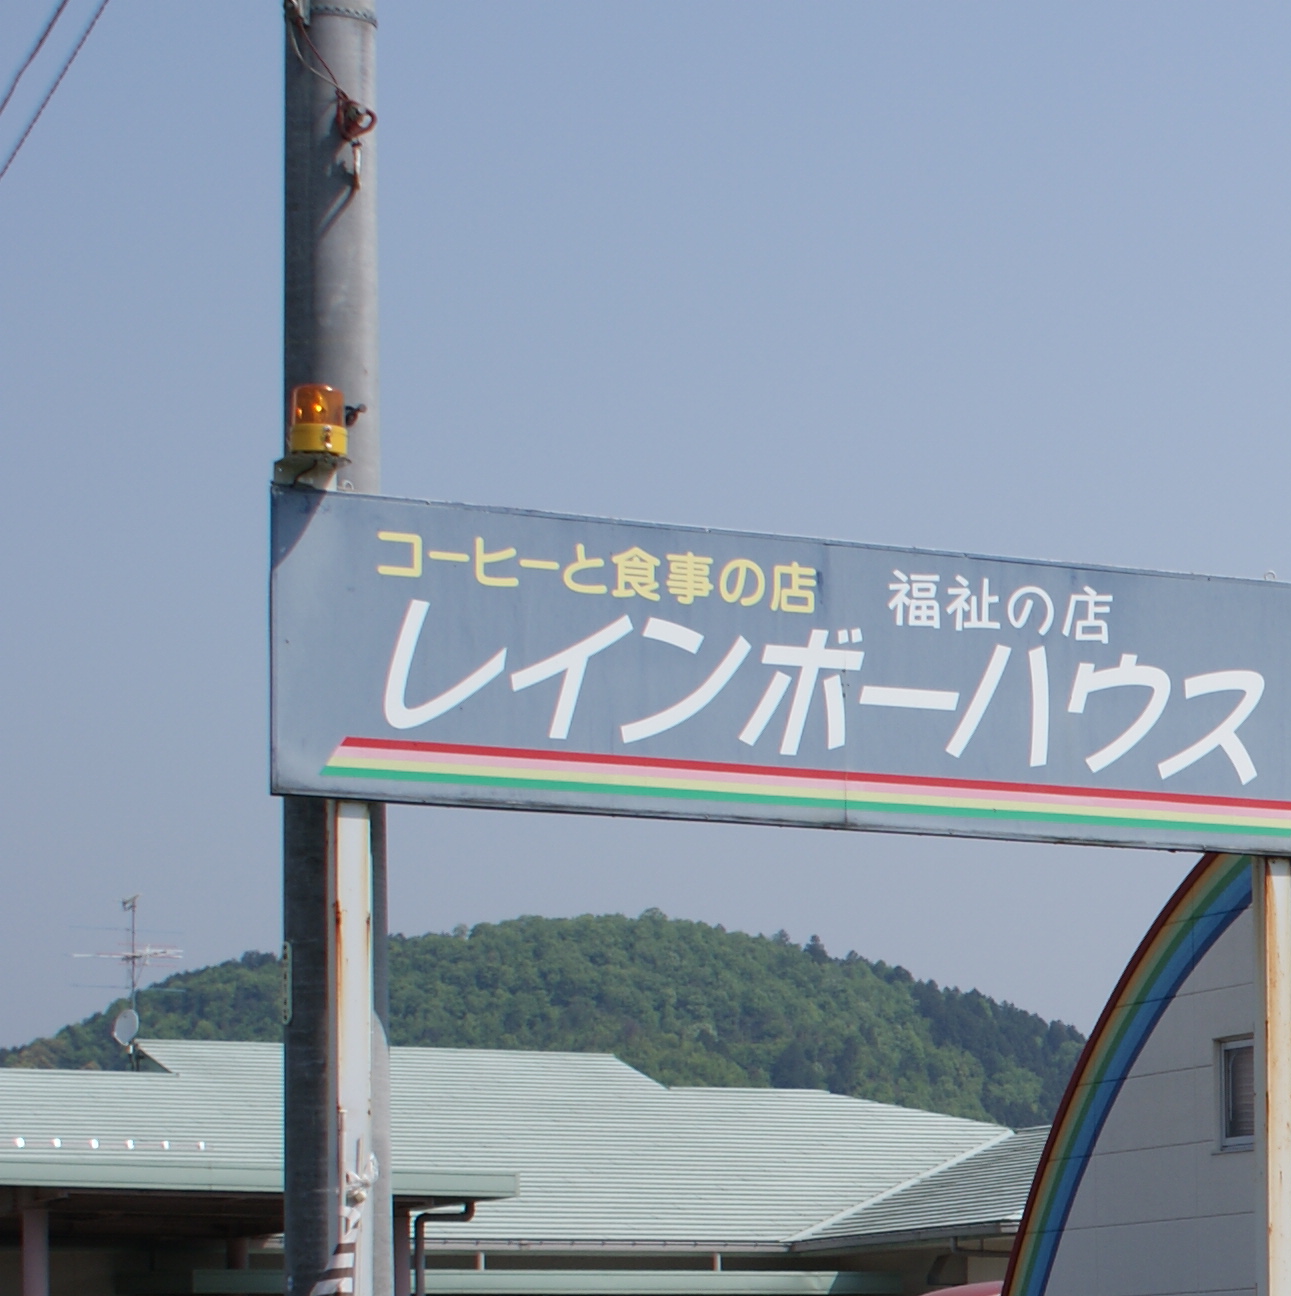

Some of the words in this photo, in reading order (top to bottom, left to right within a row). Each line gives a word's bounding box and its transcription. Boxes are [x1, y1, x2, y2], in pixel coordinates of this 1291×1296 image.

[377, 530, 817, 614] コーヒーと食事の店
[888, 569, 1114, 644] 福祉の店
[384, 600, 1265, 785] レインボーハウス
